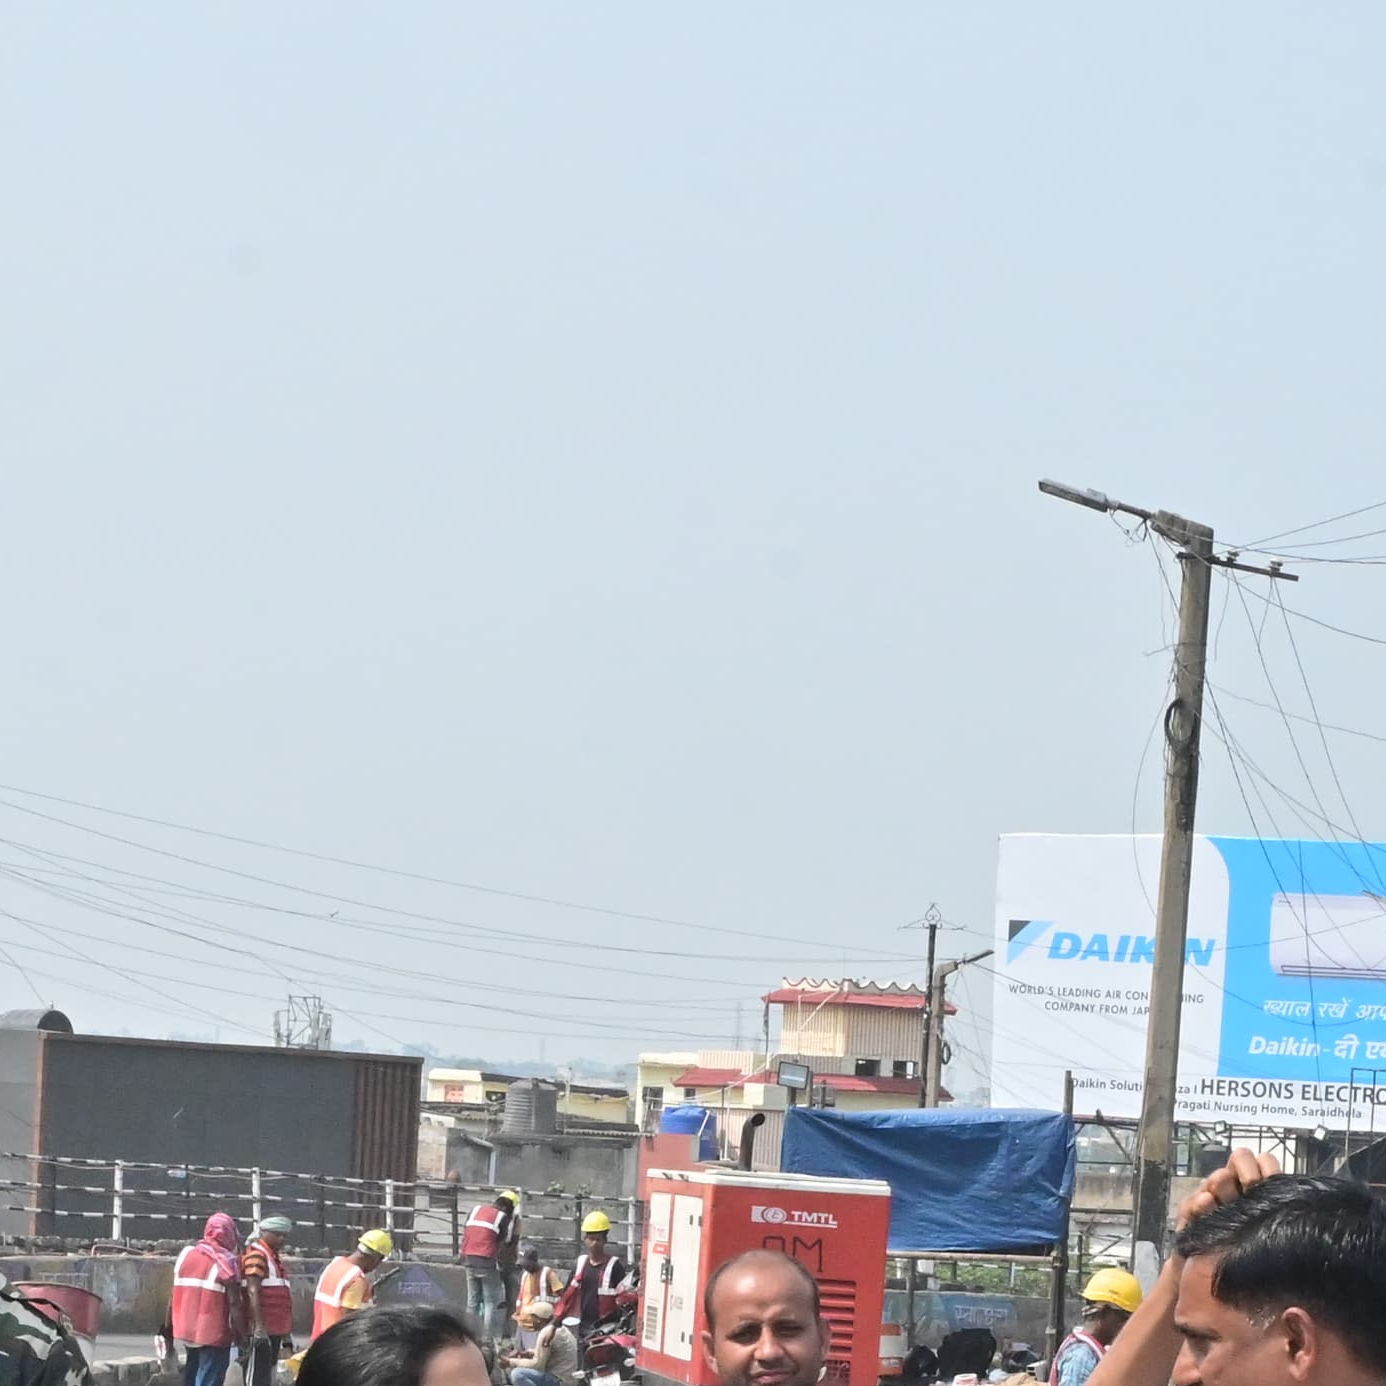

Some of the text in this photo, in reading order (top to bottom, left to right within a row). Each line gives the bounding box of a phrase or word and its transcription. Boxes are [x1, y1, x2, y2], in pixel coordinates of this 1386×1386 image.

[1048, 932, 1215, 966] DAIKN
[1009, 984, 1054, 996] WORLD'S
[1057, 987, 1101, 999] LEADING
[1105, 989, 1123, 1000] AIR
[1044, 1001, 1151, 1016] COMPANY FROM JAP
[1318, 998, 1352, 1019] रखें
[1249, 1036, 1321, 1057] Daikin
[1071, 1077, 1106, 1090] Daikin
[1201, 1078, 1294, 1101] HERSONS
[1176, 1099, 1211, 1113] ragati
[1214, 1101, 1257, 1115] Nursing
[1261, 1104, 1298, 1117] Home,
[791, 1210, 838, 1225] TMTL
